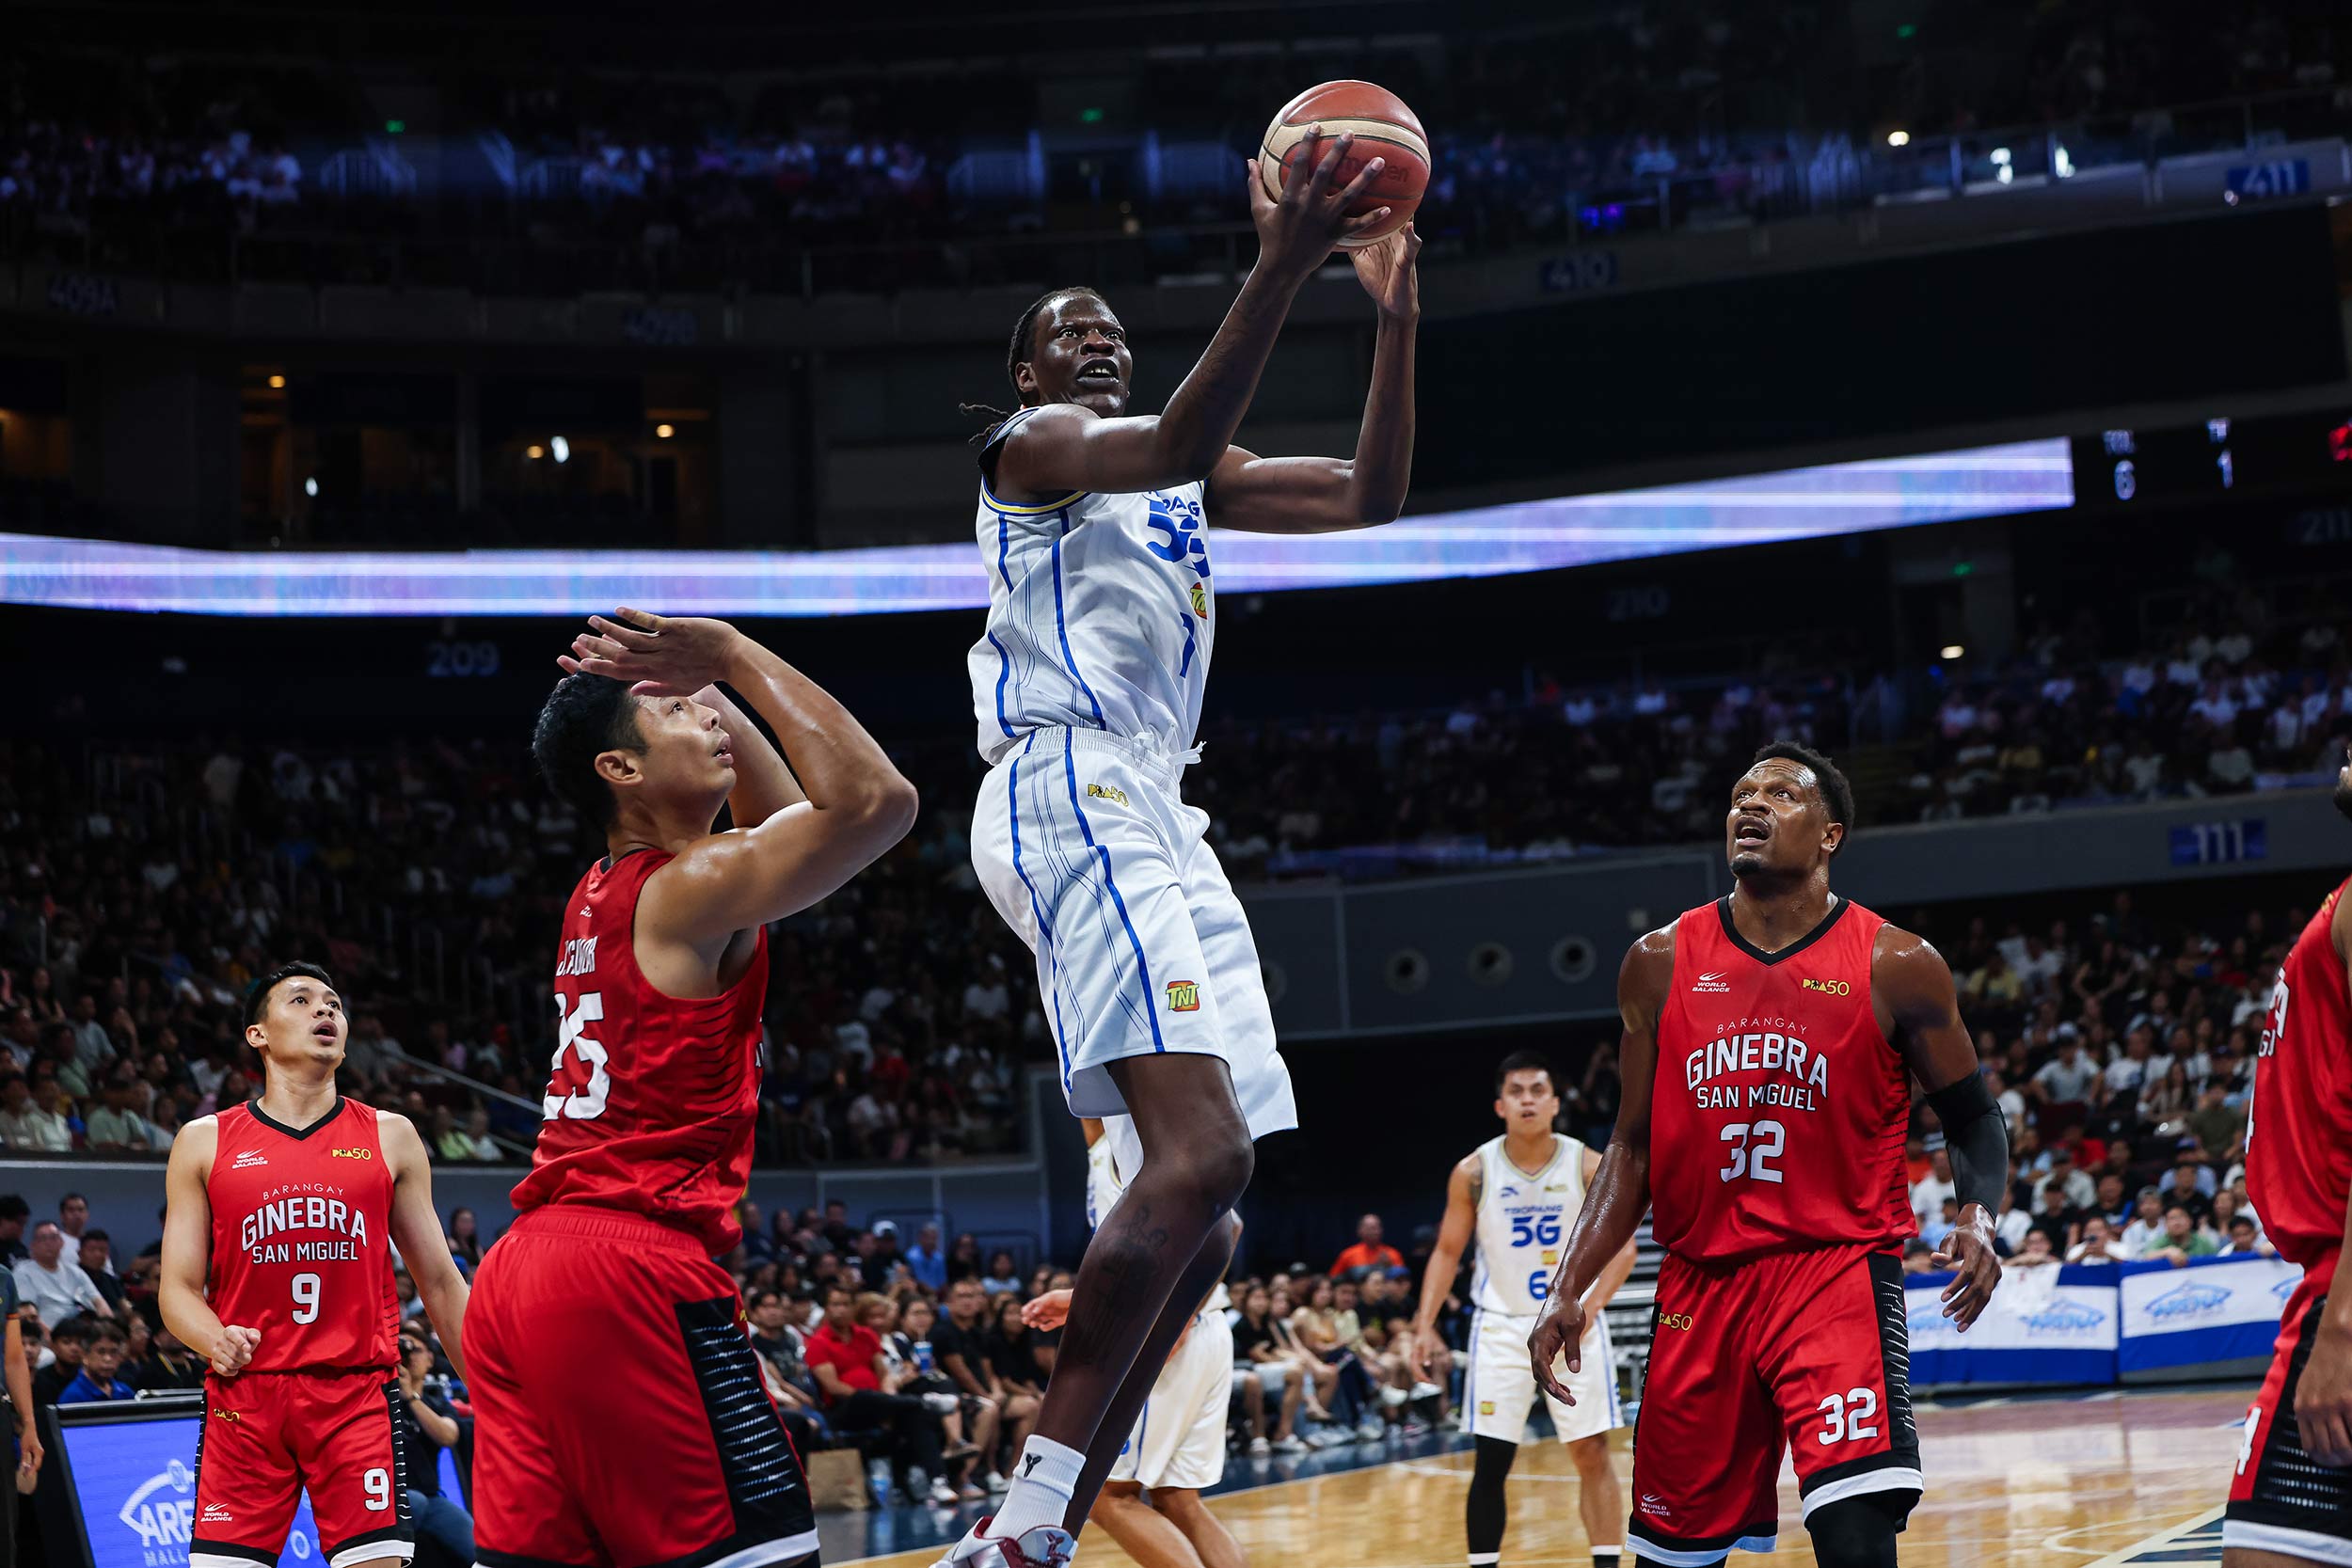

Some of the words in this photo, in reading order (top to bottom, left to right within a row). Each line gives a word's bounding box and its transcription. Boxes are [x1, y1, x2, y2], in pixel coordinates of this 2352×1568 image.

[2243, 160, 2296, 198] 411
[2115, 460, 2137, 500] 6
[427, 641, 501, 676] 209
[2191, 823, 2244, 862] 111
[1166, 983, 1200, 1011] TNT
[1717, 1017, 1807, 1034] BARANGAY
[1685, 1033, 1829, 1099] GINEBRA
[1696, 1085, 1740, 1109] SAN
[1748, 1083, 1817, 1112] MIGUEL
[231, 1160, 269, 1169] BALANCE
[235, 1156, 264, 1164] WORLD
[1720, 1119, 1786, 1183] 32
[262, 1183, 345, 1200] BARANGAY
[242, 1196, 368, 1252] GINEBRA
[1511, 1214, 1562, 1248] 5G
[252, 1243, 290, 1264] SAN
[296, 1241, 359, 1262] MIGUEL
[291, 1272, 321, 1325] 9
[1529, 1270, 1548, 1300] 6
[1816, 1386, 1878, 1446] 32
[363, 1466, 390, 1512] 9
[140, 1499, 195, 1548] ARE
[1641, 1502, 1667, 1512] WORLD
